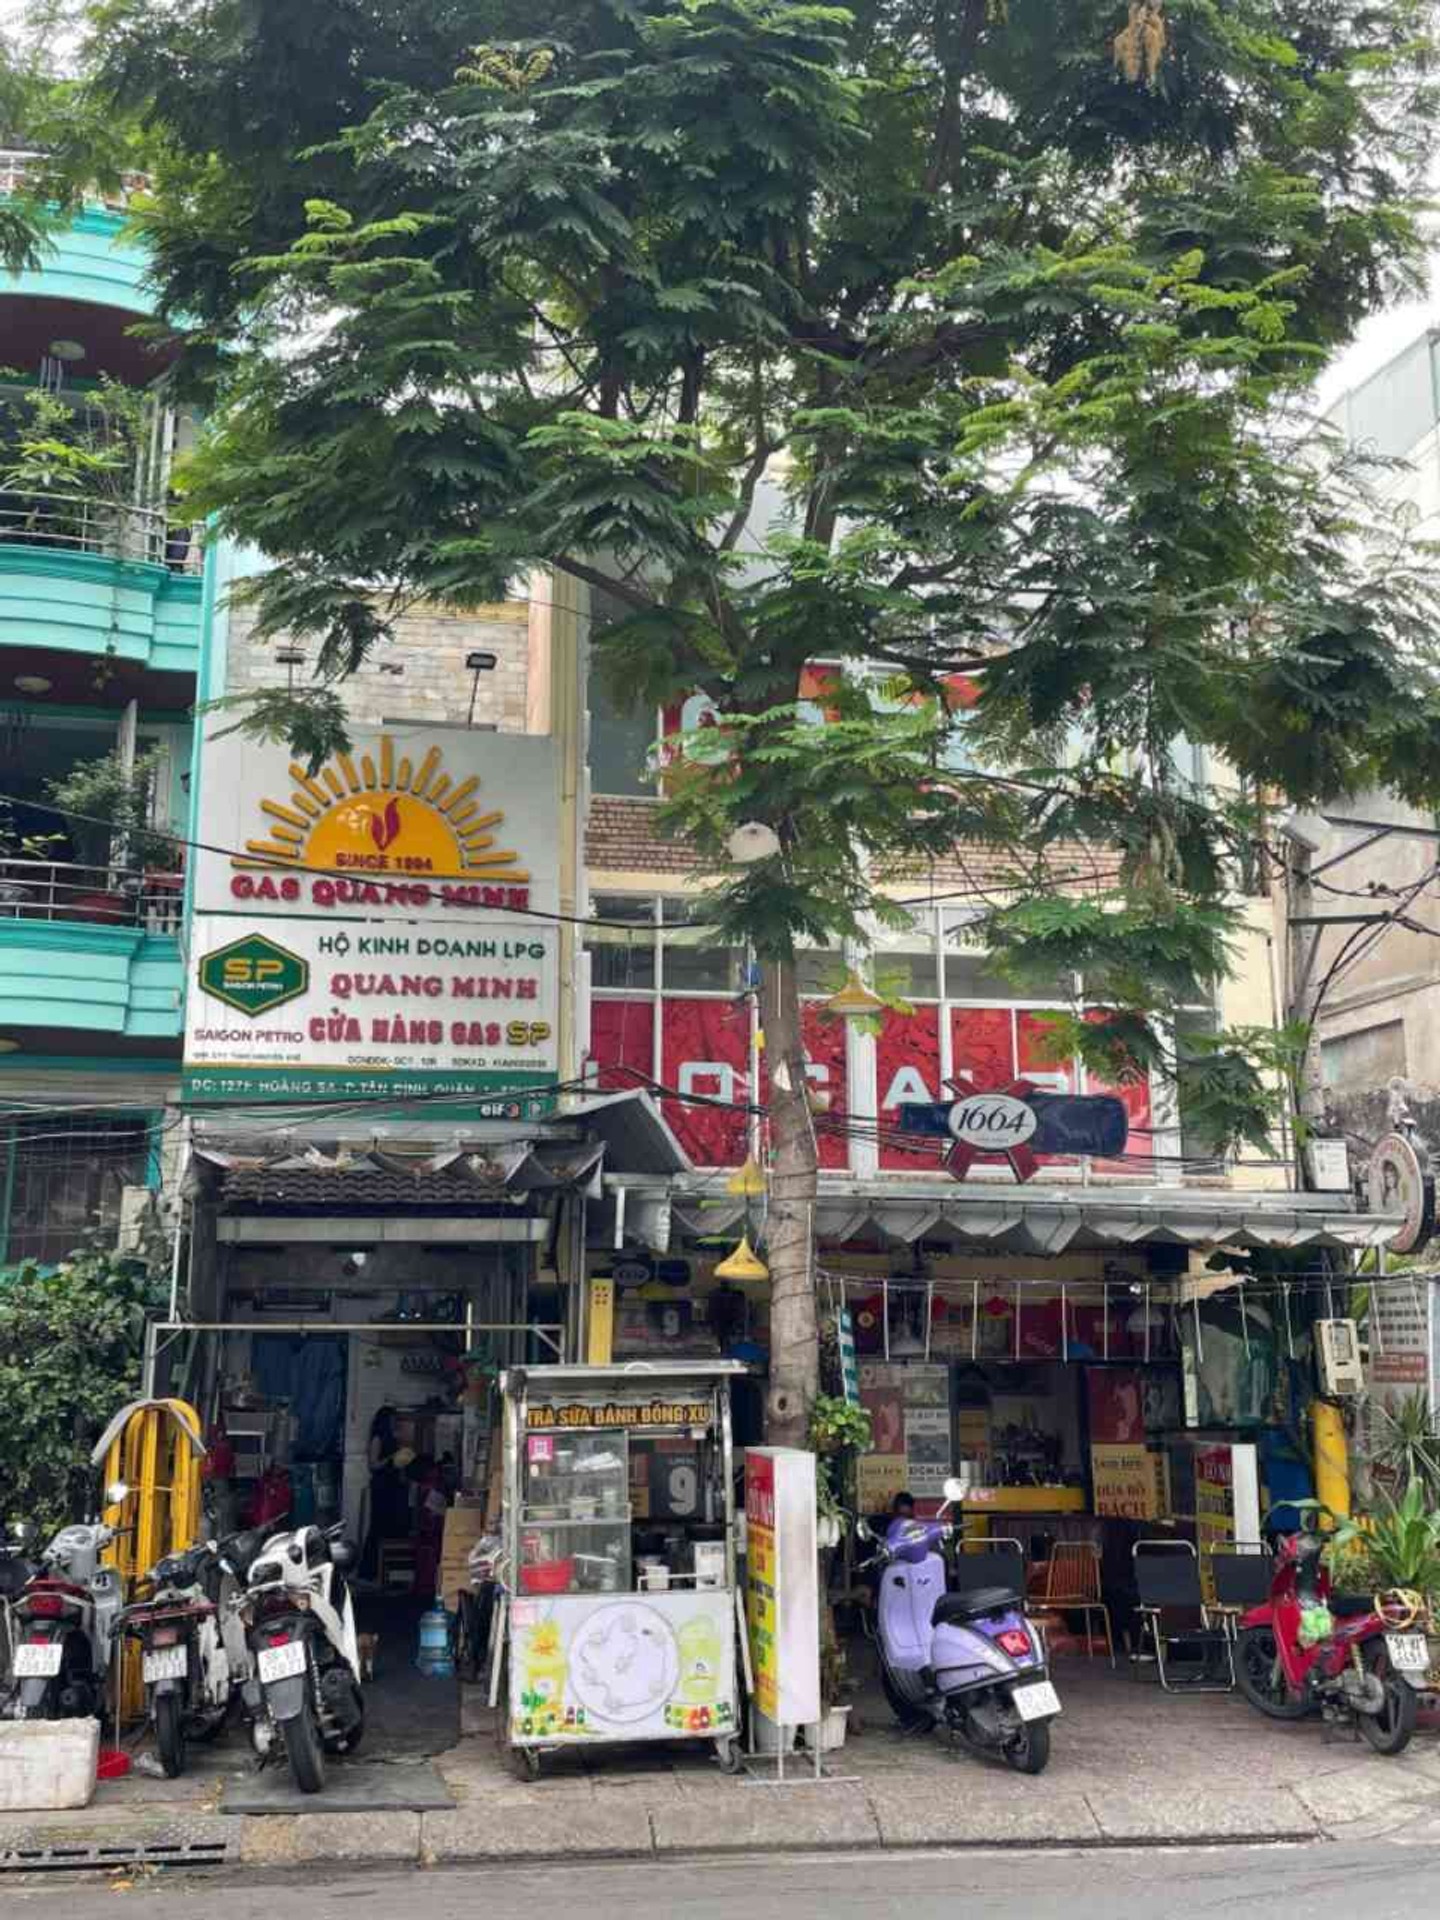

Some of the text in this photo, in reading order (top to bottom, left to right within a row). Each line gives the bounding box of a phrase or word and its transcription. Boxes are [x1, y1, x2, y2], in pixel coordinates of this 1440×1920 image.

[336, 853, 388, 869] SINCE
[230, 875, 529, 912] GAS QUANG MINH
[319, 932, 546, 959] HỘ KINH DOANH LPG
[224, 958, 284, 982] SP
[330, 973, 538, 999] QUANG MINH
[193, 1029, 304, 1043] SAIGON PETRO
[309, 1007, 551, 1046] CỬA HÀNG GAS SP
[958, 1103, 1031, 1134] 1664
[528, 1404, 554, 1427] TRÀ
[559, 1404, 589, 1427] SỮA
[688, 1404, 709, 1424] XU
[669, 1465, 697, 1516] 9
